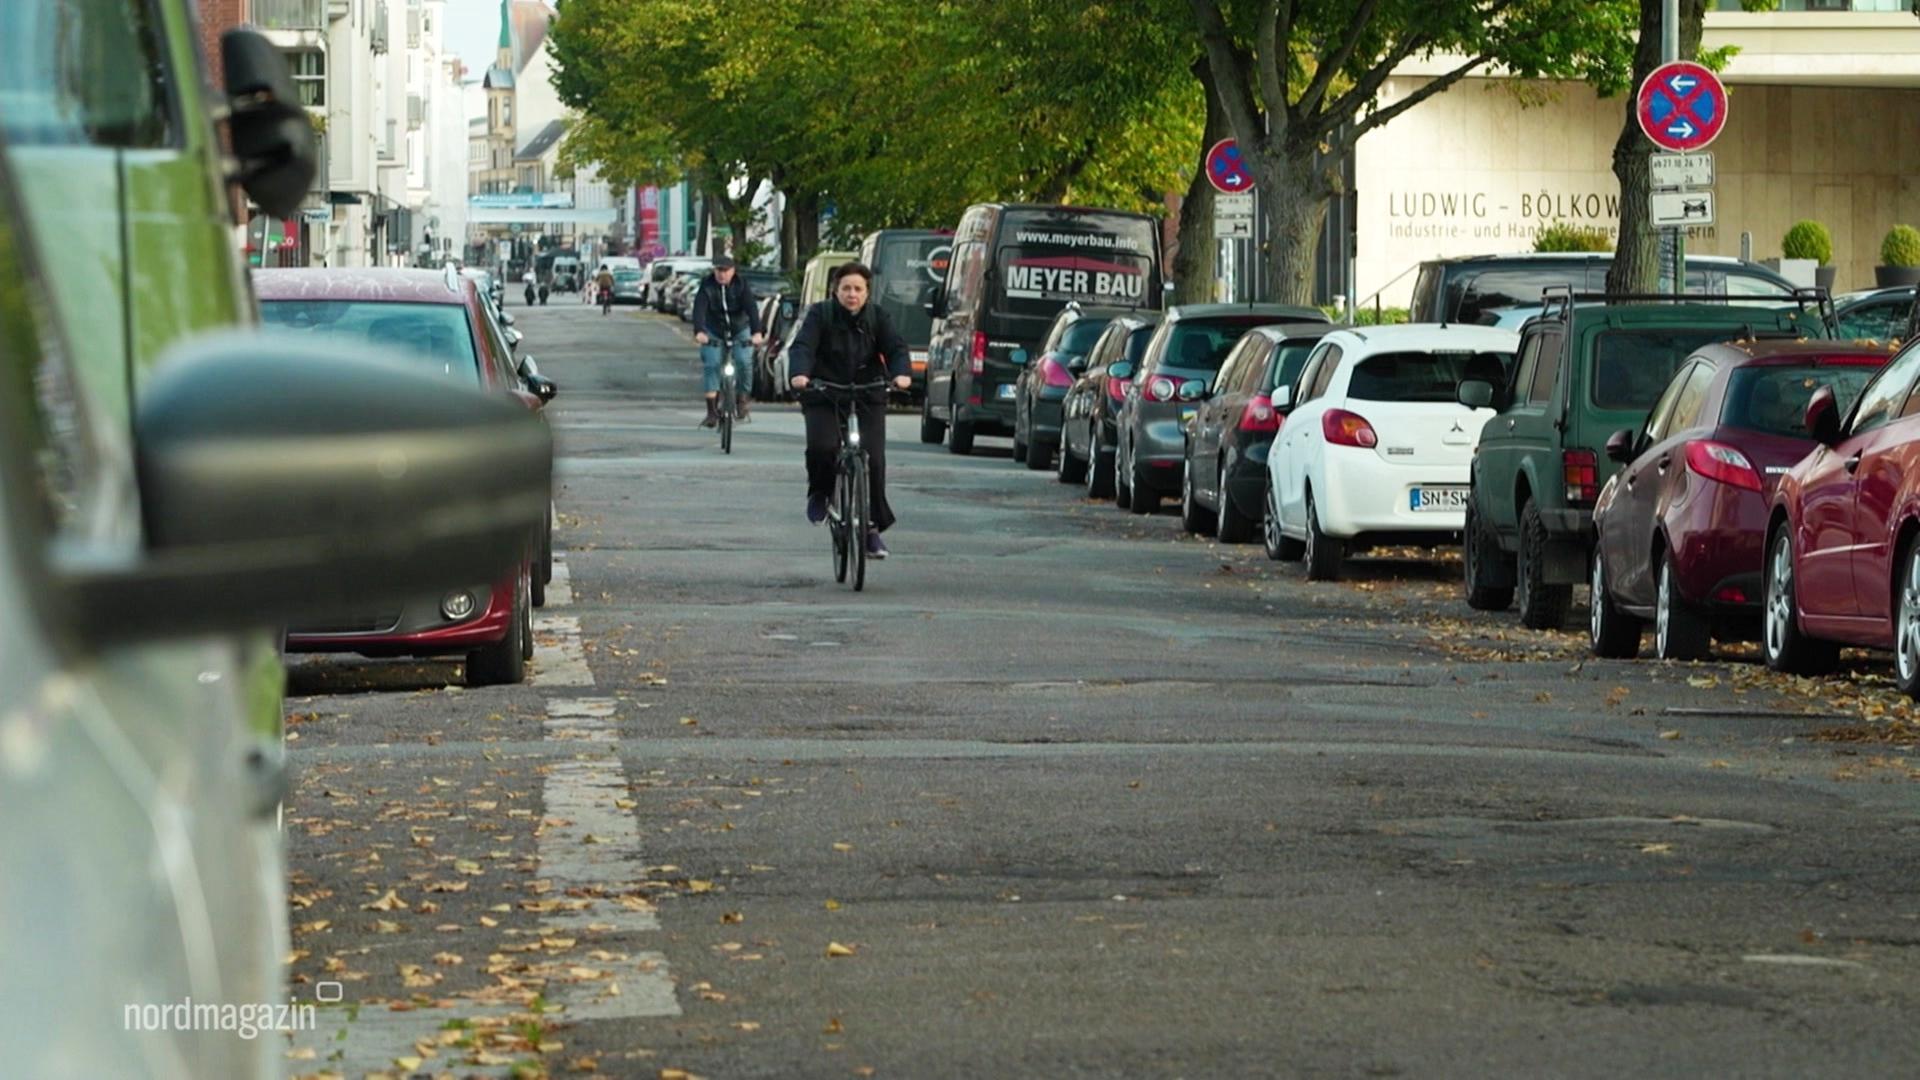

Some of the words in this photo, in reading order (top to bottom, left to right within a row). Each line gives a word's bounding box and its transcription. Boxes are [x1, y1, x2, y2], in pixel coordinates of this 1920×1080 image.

[1390, 192, 1486, 218] LUDWIG
[1016, 230, 1138, 250] www.meyerbau.info
[1389, 222, 1466, 238] Industrie-
[1473, 222, 1501, 238] und
[1007, 264, 1089, 294] MEYER
[1095, 271, 1142, 297] BAU
